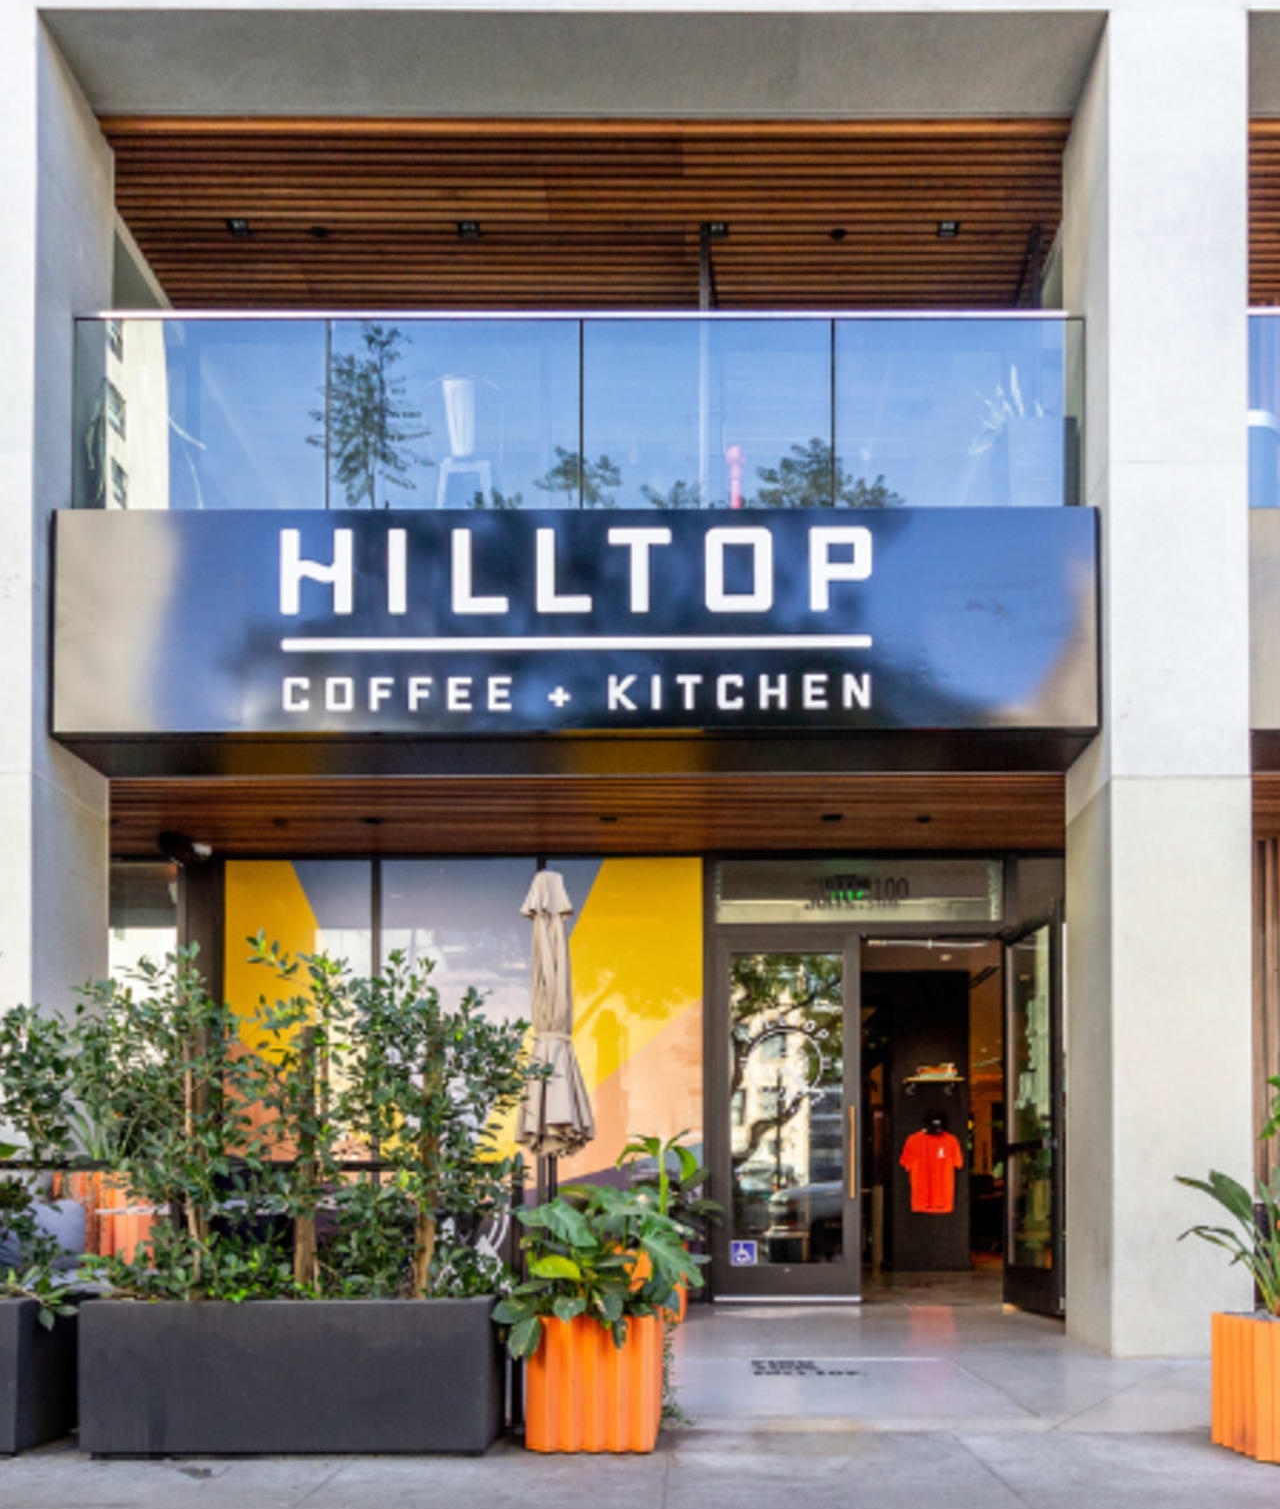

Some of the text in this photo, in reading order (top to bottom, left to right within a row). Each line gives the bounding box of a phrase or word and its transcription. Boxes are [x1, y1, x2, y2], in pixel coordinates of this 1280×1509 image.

[279, 527, 873, 615] HILLTOP
[282, 676, 513, 712] COFFEE
[607, 674, 872, 711] KITCHEN
